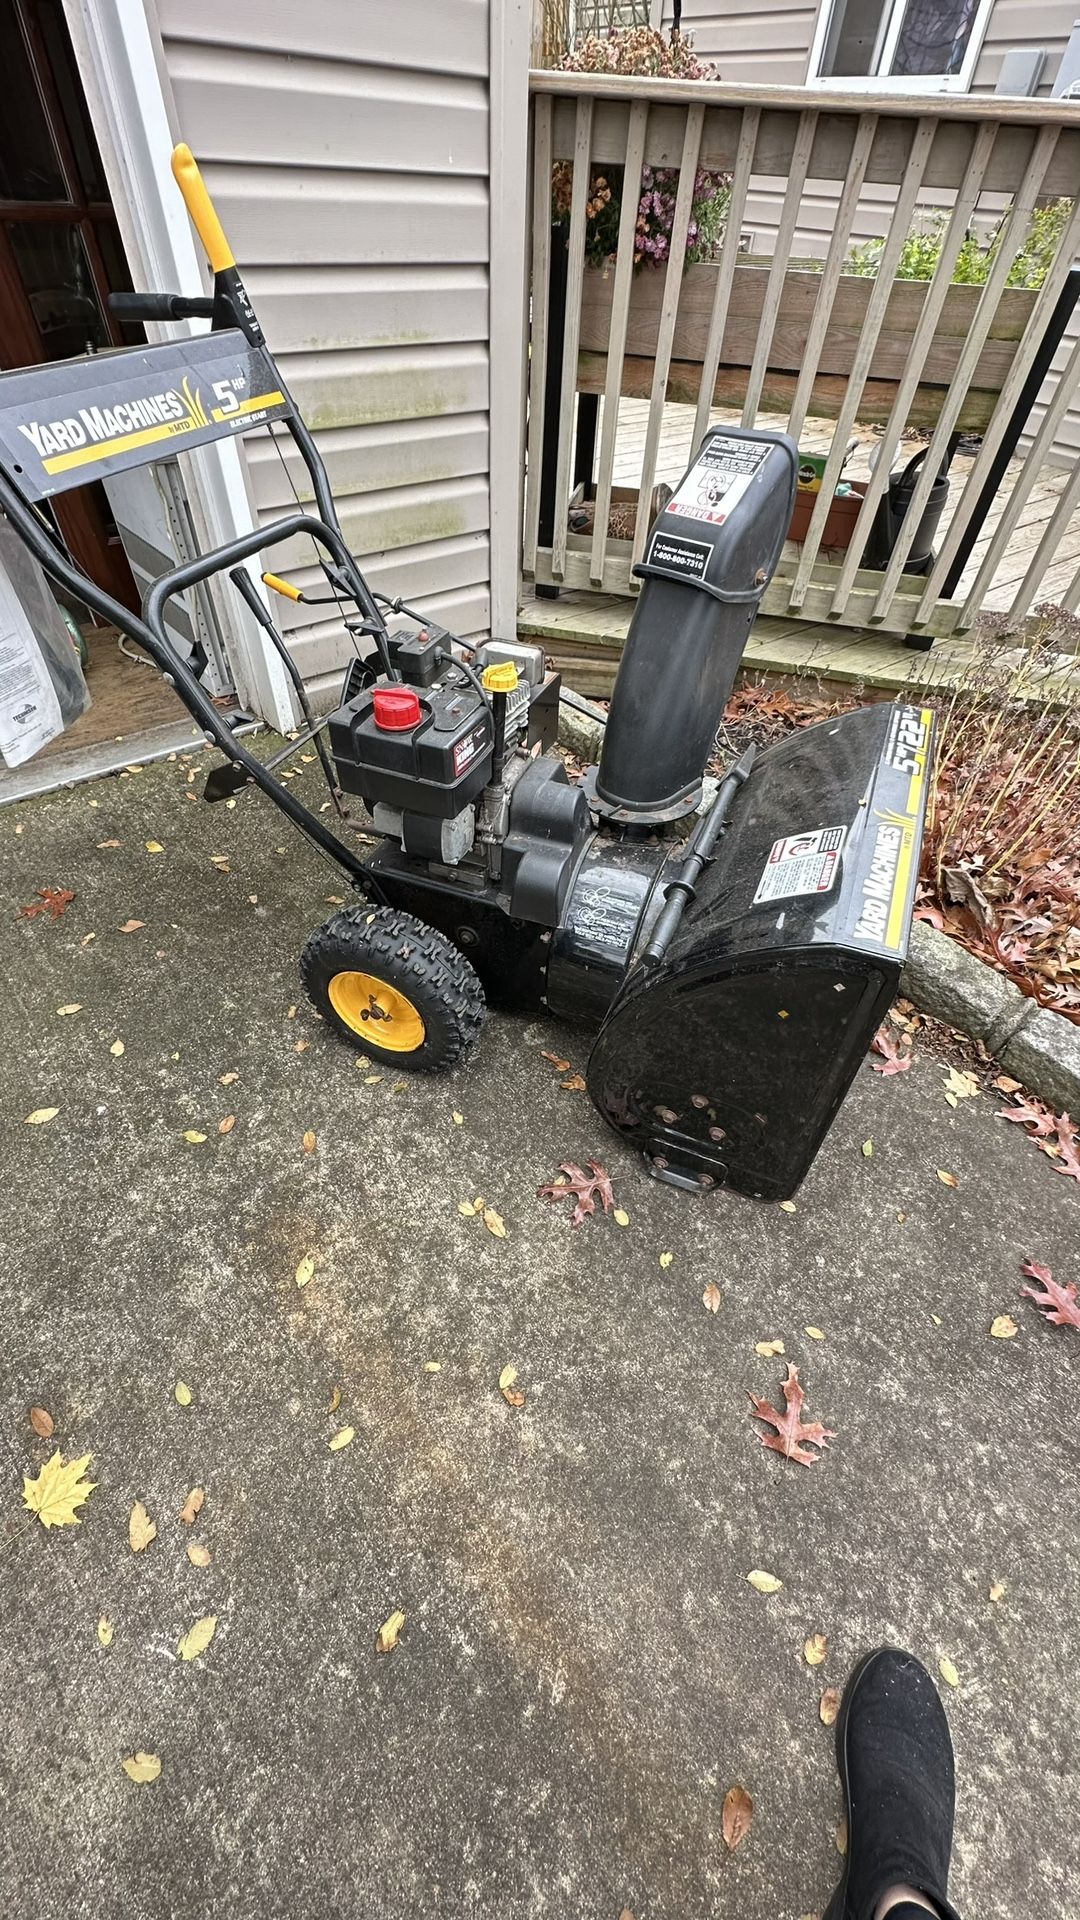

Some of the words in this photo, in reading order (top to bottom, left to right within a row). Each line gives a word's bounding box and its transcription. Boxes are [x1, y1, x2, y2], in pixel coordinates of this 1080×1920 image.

[18, 420, 88, 457] YARD
[78, 390, 184, 441] MACHINES
[174, 421, 190, 432] MTD
[674, 503, 708, 521] DANGER
[653, 550, 704, 570] 1-800-800-7310
[863, 825, 901, 902] MACHINES
[853, 898, 889, 942] YARD
